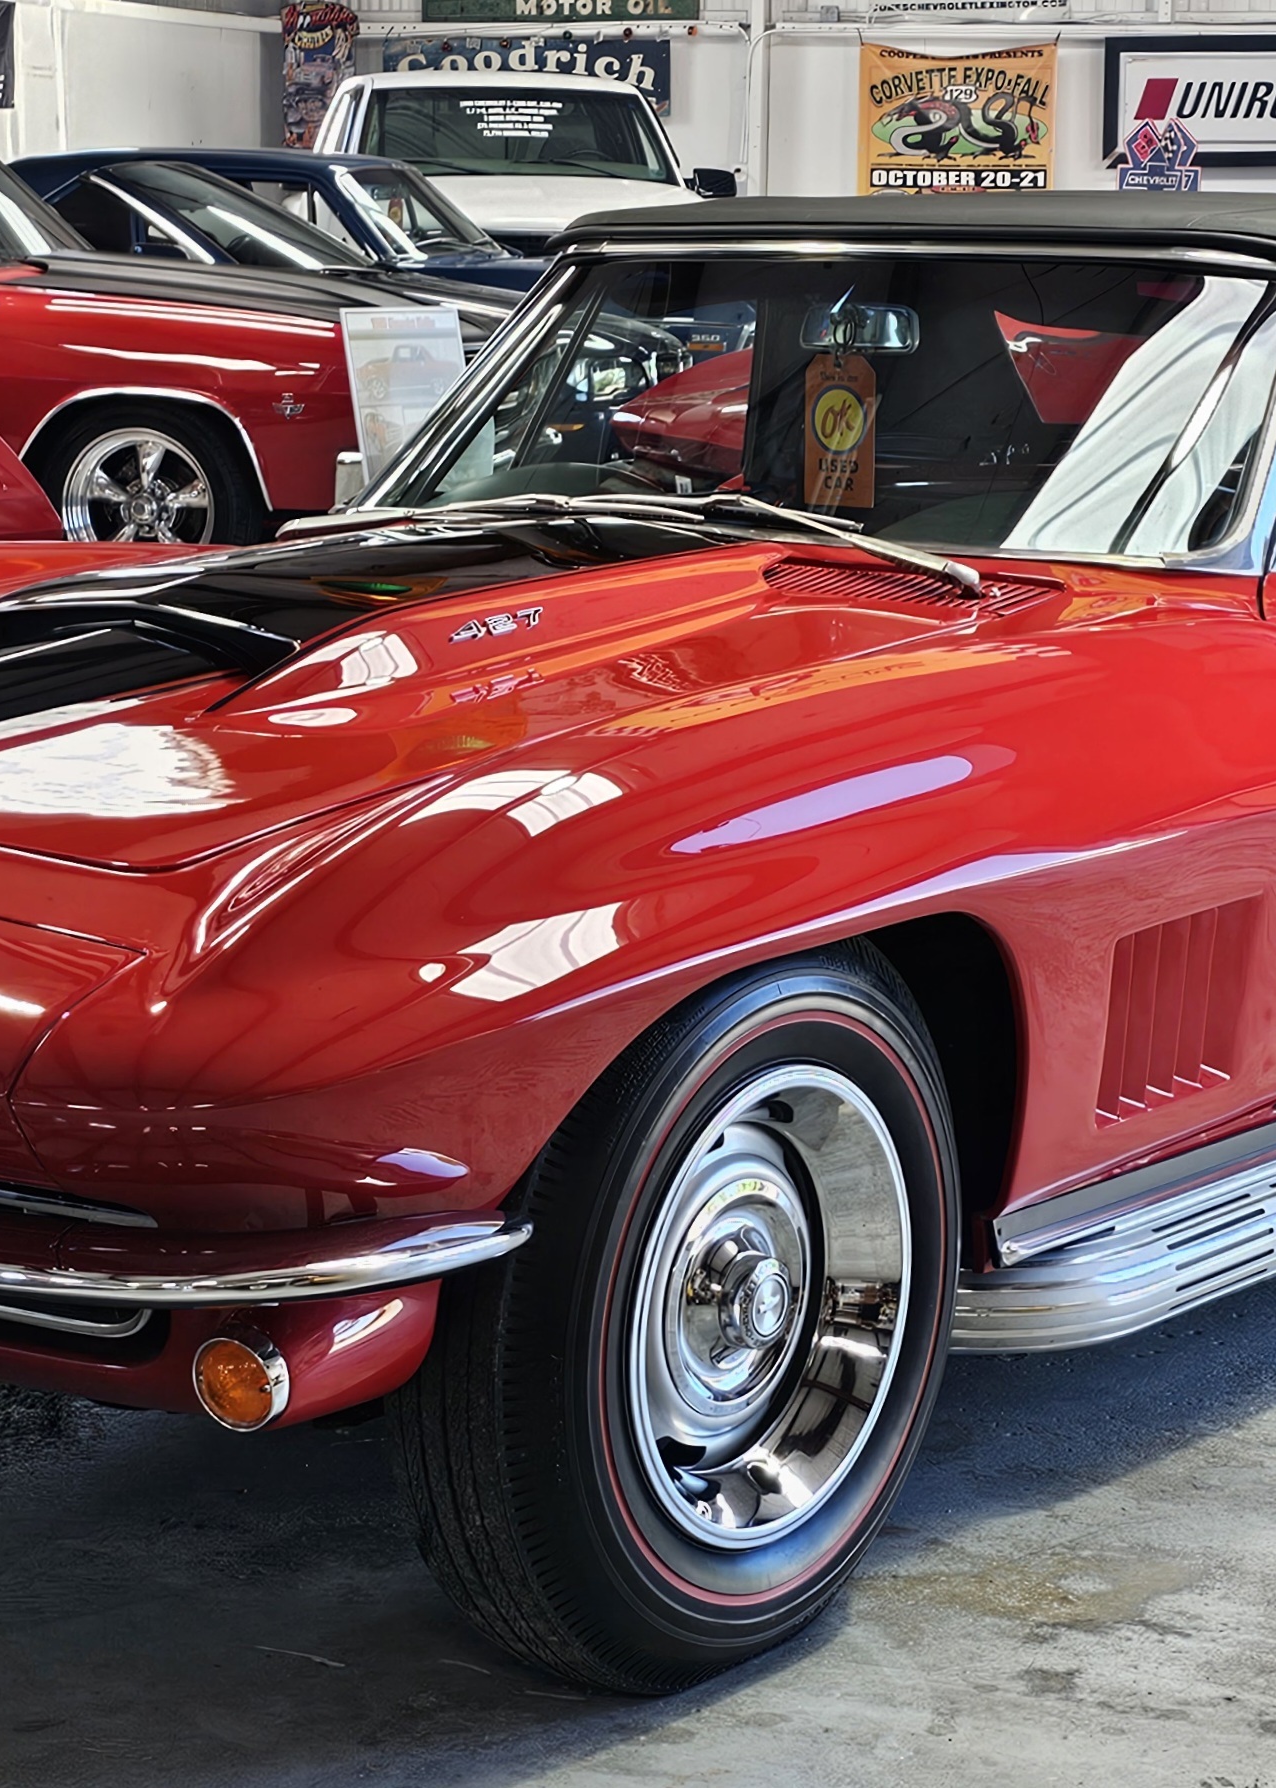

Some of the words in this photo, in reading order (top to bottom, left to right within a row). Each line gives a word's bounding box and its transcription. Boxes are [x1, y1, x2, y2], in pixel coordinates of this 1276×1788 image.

[516, 0, 611, 15] MOTOR
[627, 0, 672, 14] OIL
[869, 66, 958, 105] CORVETTE
[947, 88, 974, 101] 129
[872, 169, 975, 187] OCTOBER
[980, 171, 1045, 188] 20-21
[1128, 175, 1177, 185] CHEVROLET
[820, 399, 855, 439] OK
[818, 458, 859, 474] USED
[824, 475, 854, 492] CAR
[448, 606, 544, 644] 427
